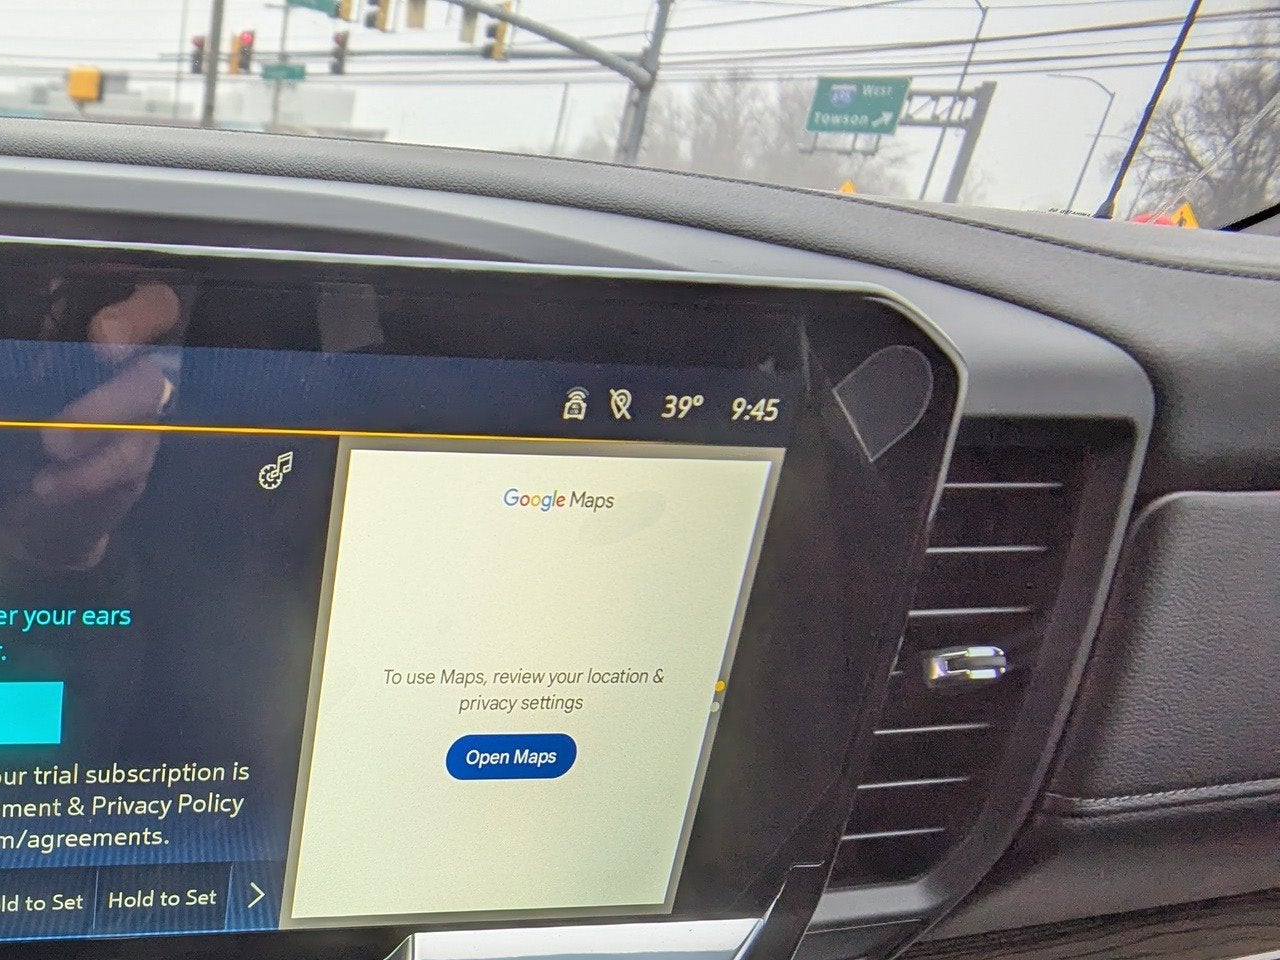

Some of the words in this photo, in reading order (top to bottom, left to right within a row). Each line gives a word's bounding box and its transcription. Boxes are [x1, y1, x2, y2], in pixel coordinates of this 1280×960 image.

[732, 396, 780, 421] 9:45
[504, 488, 566, 512] Google
[570, 491, 614, 512] Maps
[22, 608, 76, 632] your
[82, 608, 132, 626] ears
[384, 669, 402, 685] To
[406, 670, 435, 684] use
[440, 669, 488, 689] Maps,
[493, 668, 544, 684] review
[547, 671, 583, 688] your
[587, 667, 649, 684] location
[653, 668, 665, 684] &
[459, 695, 518, 714] privacy
[521, 694, 584, 714] settings
[466, 749, 509, 768] Open
[513, 748, 558, 768] Maps
[33, 763, 79, 785] trial
[85, 762, 225, 788] subscription
[232, 761, 250, 781] is
[67, 796, 85, 816] &
[92, 793, 172, 820] Privacy
[177, 792, 245, 818] Policy
[25, 896, 46, 911] to
[51, 894, 84, 911] Set
[108, 890, 155, 909] Hold
[160, 891, 180, 907] to
[185, 889, 217, 906] Set
